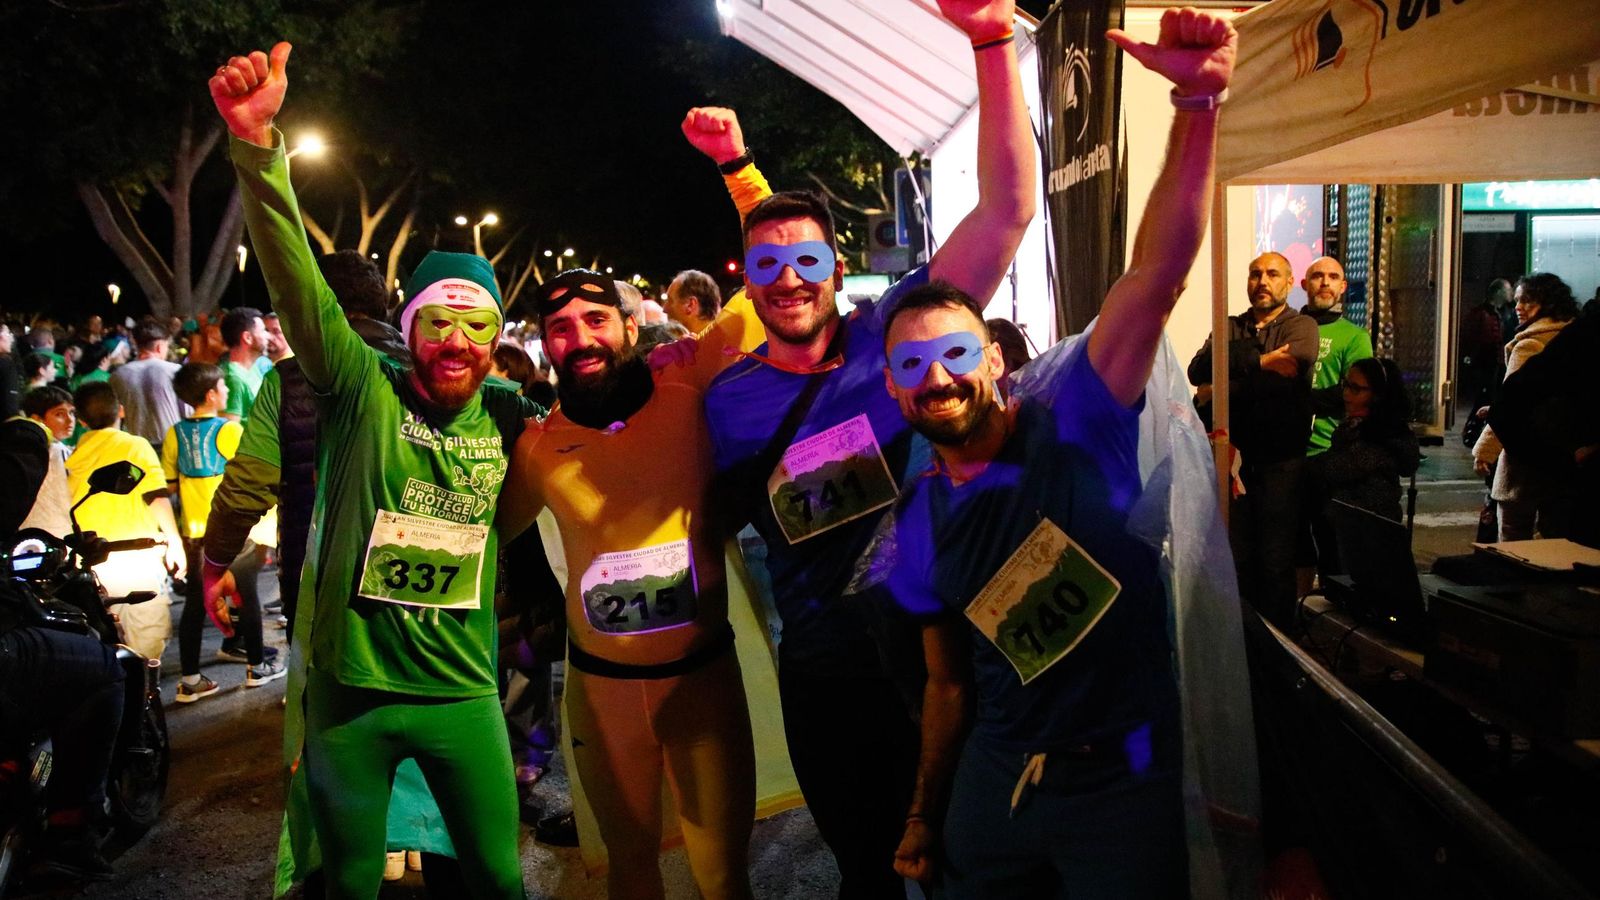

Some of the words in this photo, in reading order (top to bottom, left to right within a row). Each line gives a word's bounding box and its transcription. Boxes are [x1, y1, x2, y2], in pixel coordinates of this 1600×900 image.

[447, 436, 503, 448] SILVESTRE
[806, 433, 827, 446] CIUDAD
[406, 487, 471, 515] PROTEGE
[410, 481, 435, 494] CUIDA
[437, 488, 447, 498] TU
[448, 493, 472, 504] SALUD
[789, 471, 866, 521] 741
[403, 499, 417, 510] TU
[418, 505, 467, 523] ENTORNO
[406, 518, 435, 527] SILVESTRE
[436, 522, 456, 530] CIUDAD
[605, 553, 633, 561] SILVESTRE
[633, 549, 655, 558] CIUDAD
[384, 558, 460, 595] 337
[603, 587, 677, 624] 215
[1013, 580, 1089, 655] 740
